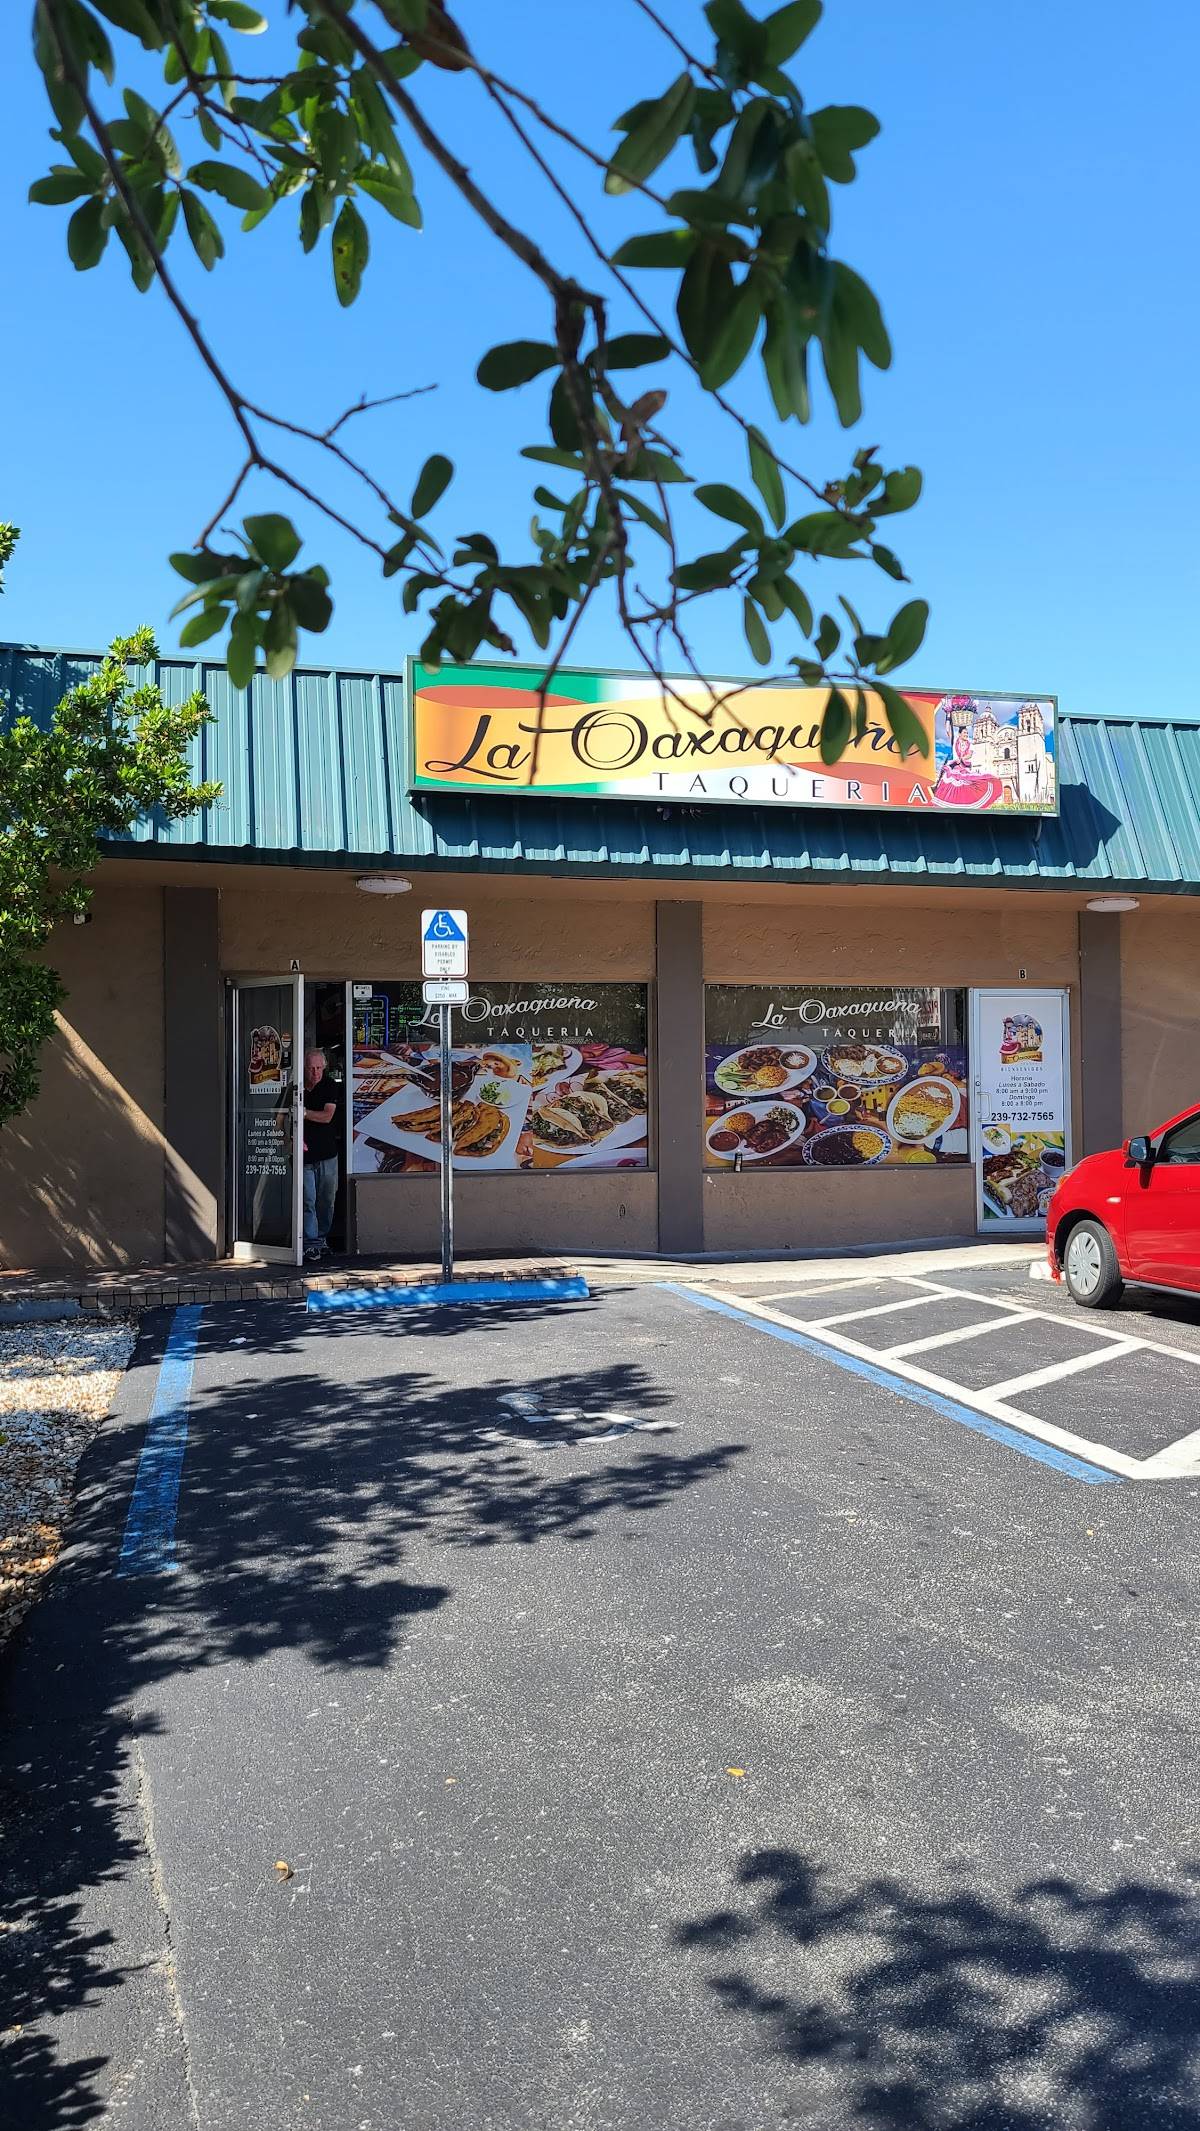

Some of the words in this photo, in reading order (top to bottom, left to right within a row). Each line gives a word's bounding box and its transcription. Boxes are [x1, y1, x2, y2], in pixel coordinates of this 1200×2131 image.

[424, 714, 531, 780] La
[518, 708, 922, 772] Oaxaquñ
[650, 771, 929, 803] TAQUERIA
[291, 960, 299, 970] A
[1019, 969, 1026, 979] B
[451, 996, 599, 1023] Oaxaqueña
[751, 1003, 788, 1030] La
[781, 998, 922, 1024] Oaxaqueña
[487, 1027, 594, 1037] TAQUERIA
[821, 1028, 918, 1039] TAQUERIA
[991, 1111, 1054, 1121] 239-732-7565
[254, 1118, 277, 1127] Horario
[266, 1129, 285, 1137] Sabado
[255, 1147, 277, 1155] Domingo
[245, 1164, 287, 1175] 239-732-7565
